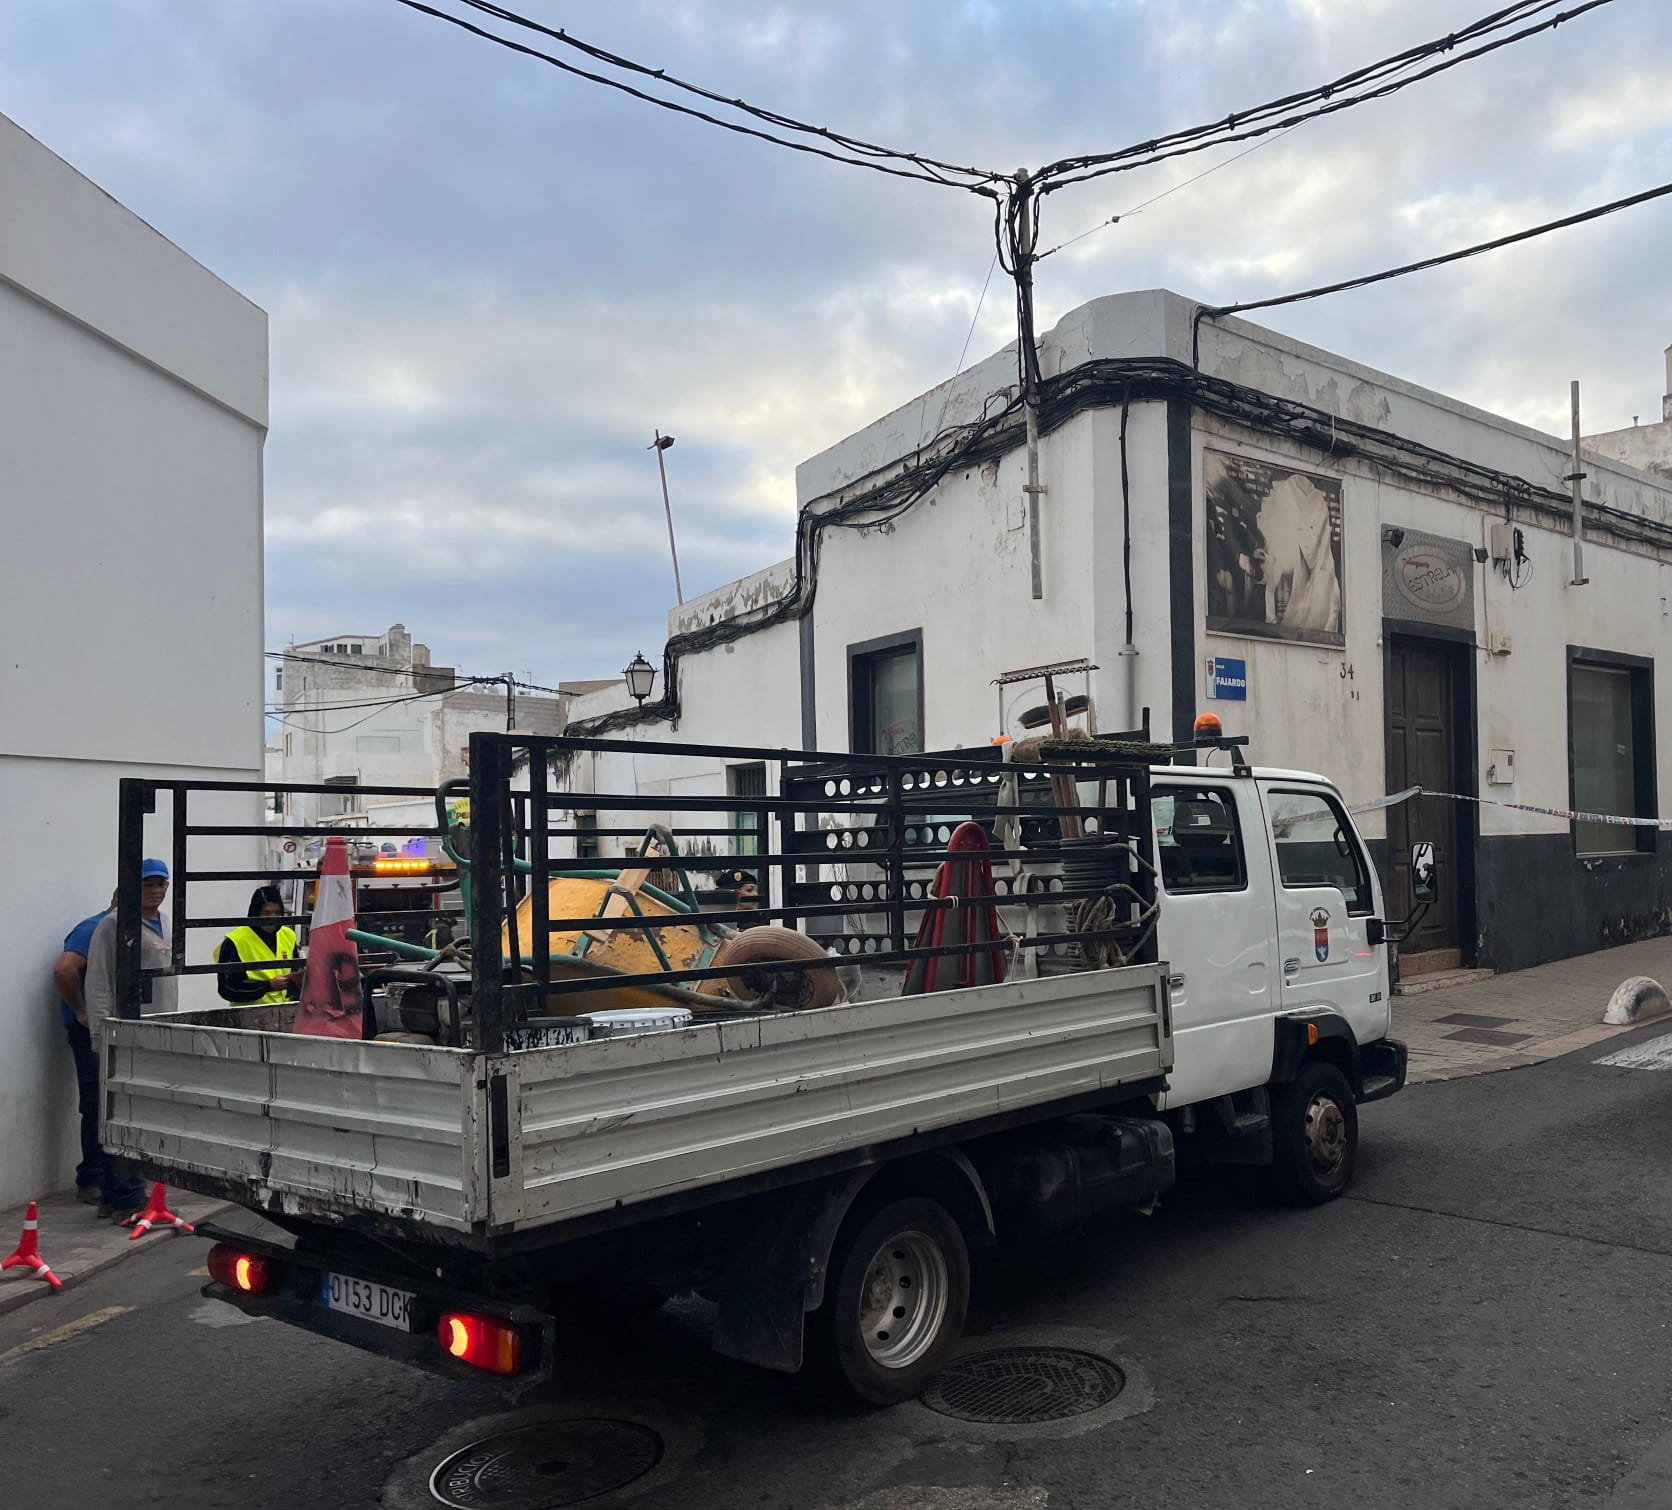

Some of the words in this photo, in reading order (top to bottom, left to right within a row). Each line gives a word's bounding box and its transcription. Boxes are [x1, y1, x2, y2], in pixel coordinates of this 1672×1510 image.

[1340, 662, 1354, 680] 34
[1216, 676, 1246, 688] FAJARDO
[331, 1275, 372, 1312] 0153
[379, 1288, 411, 1323] DCK
